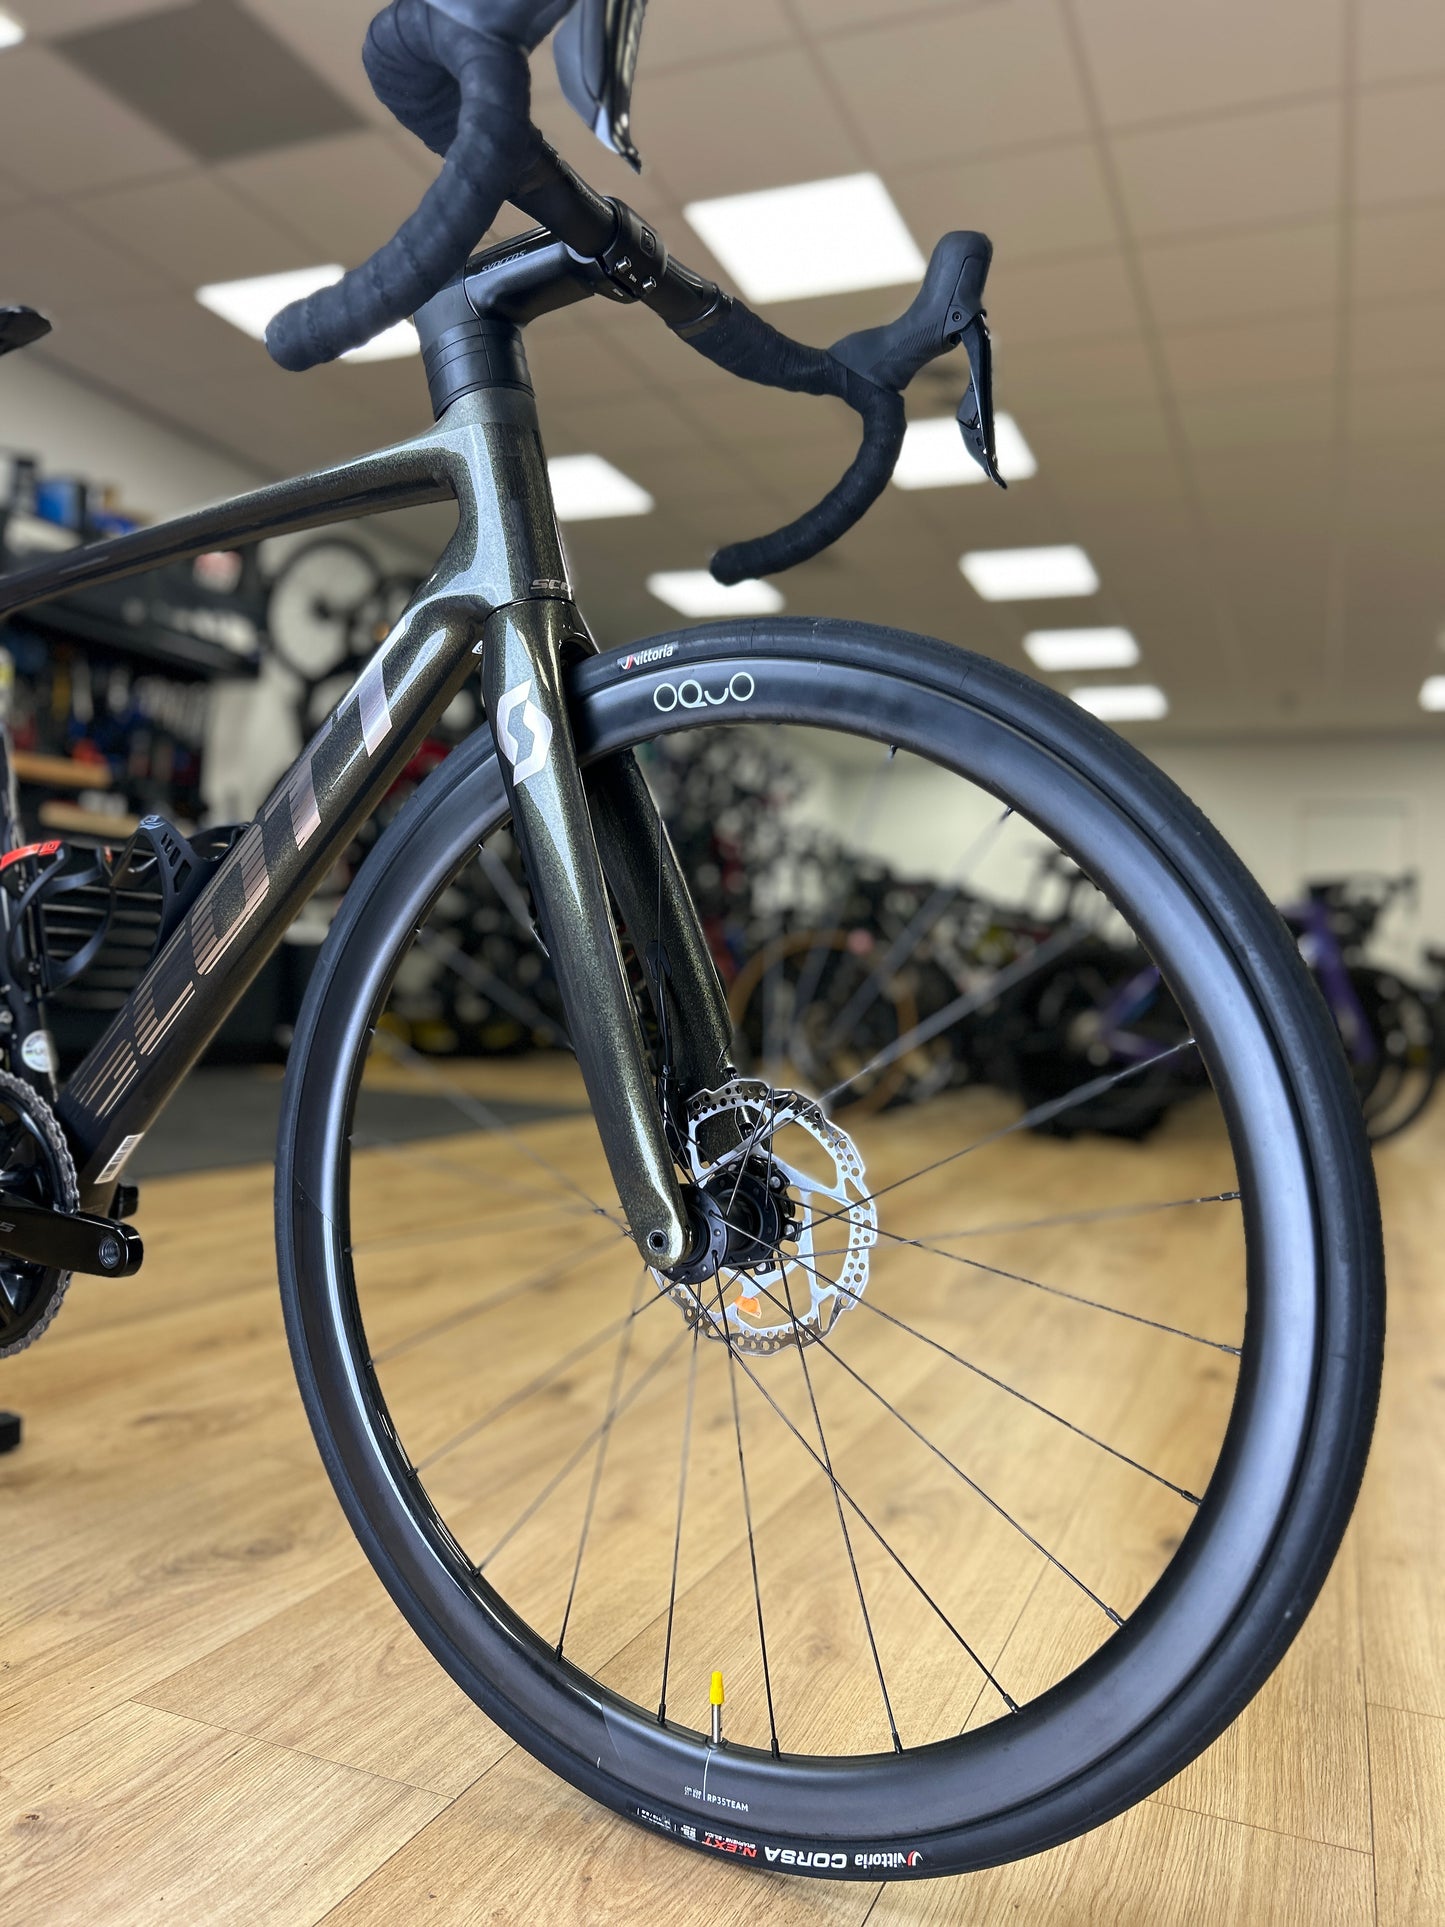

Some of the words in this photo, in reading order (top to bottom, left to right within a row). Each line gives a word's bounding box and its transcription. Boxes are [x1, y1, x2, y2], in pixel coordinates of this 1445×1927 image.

[653, 671, 755, 712] OQUO
[707, 1793, 749, 1812] RP35TEAM
[764, 1846, 848, 1869] CORSA
